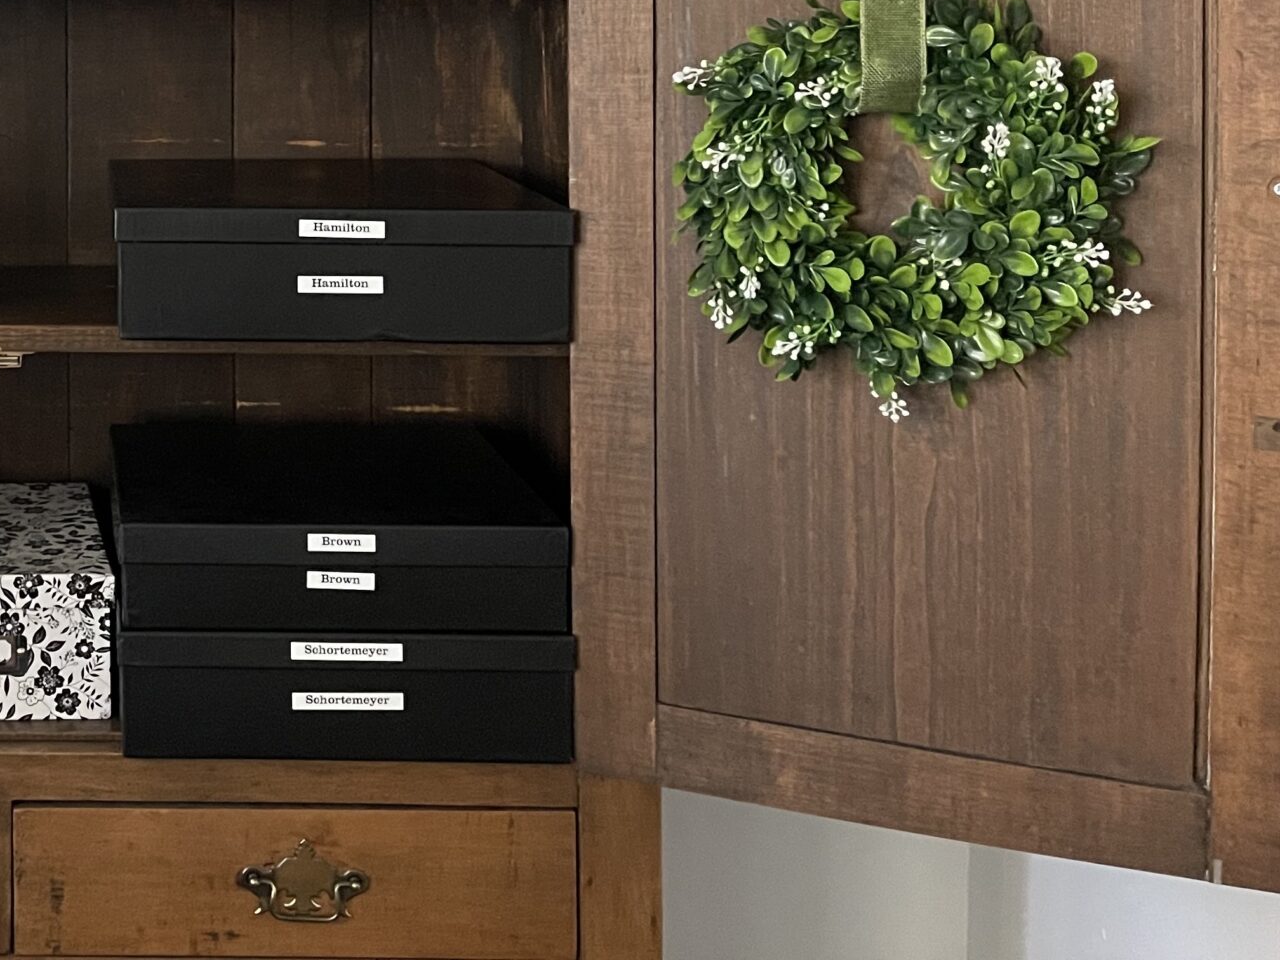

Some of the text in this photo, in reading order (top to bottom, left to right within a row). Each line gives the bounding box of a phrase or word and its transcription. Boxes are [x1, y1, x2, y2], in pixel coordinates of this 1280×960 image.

[313, 222, 370, 233] Hamilton
[311, 278, 369, 288] Hamilton
[321, 536, 361, 546] Brown
[320, 574, 361, 584] Brown
[304, 644, 389, 657] Schortemeyer
[305, 694, 390, 706] Schortemeyer
